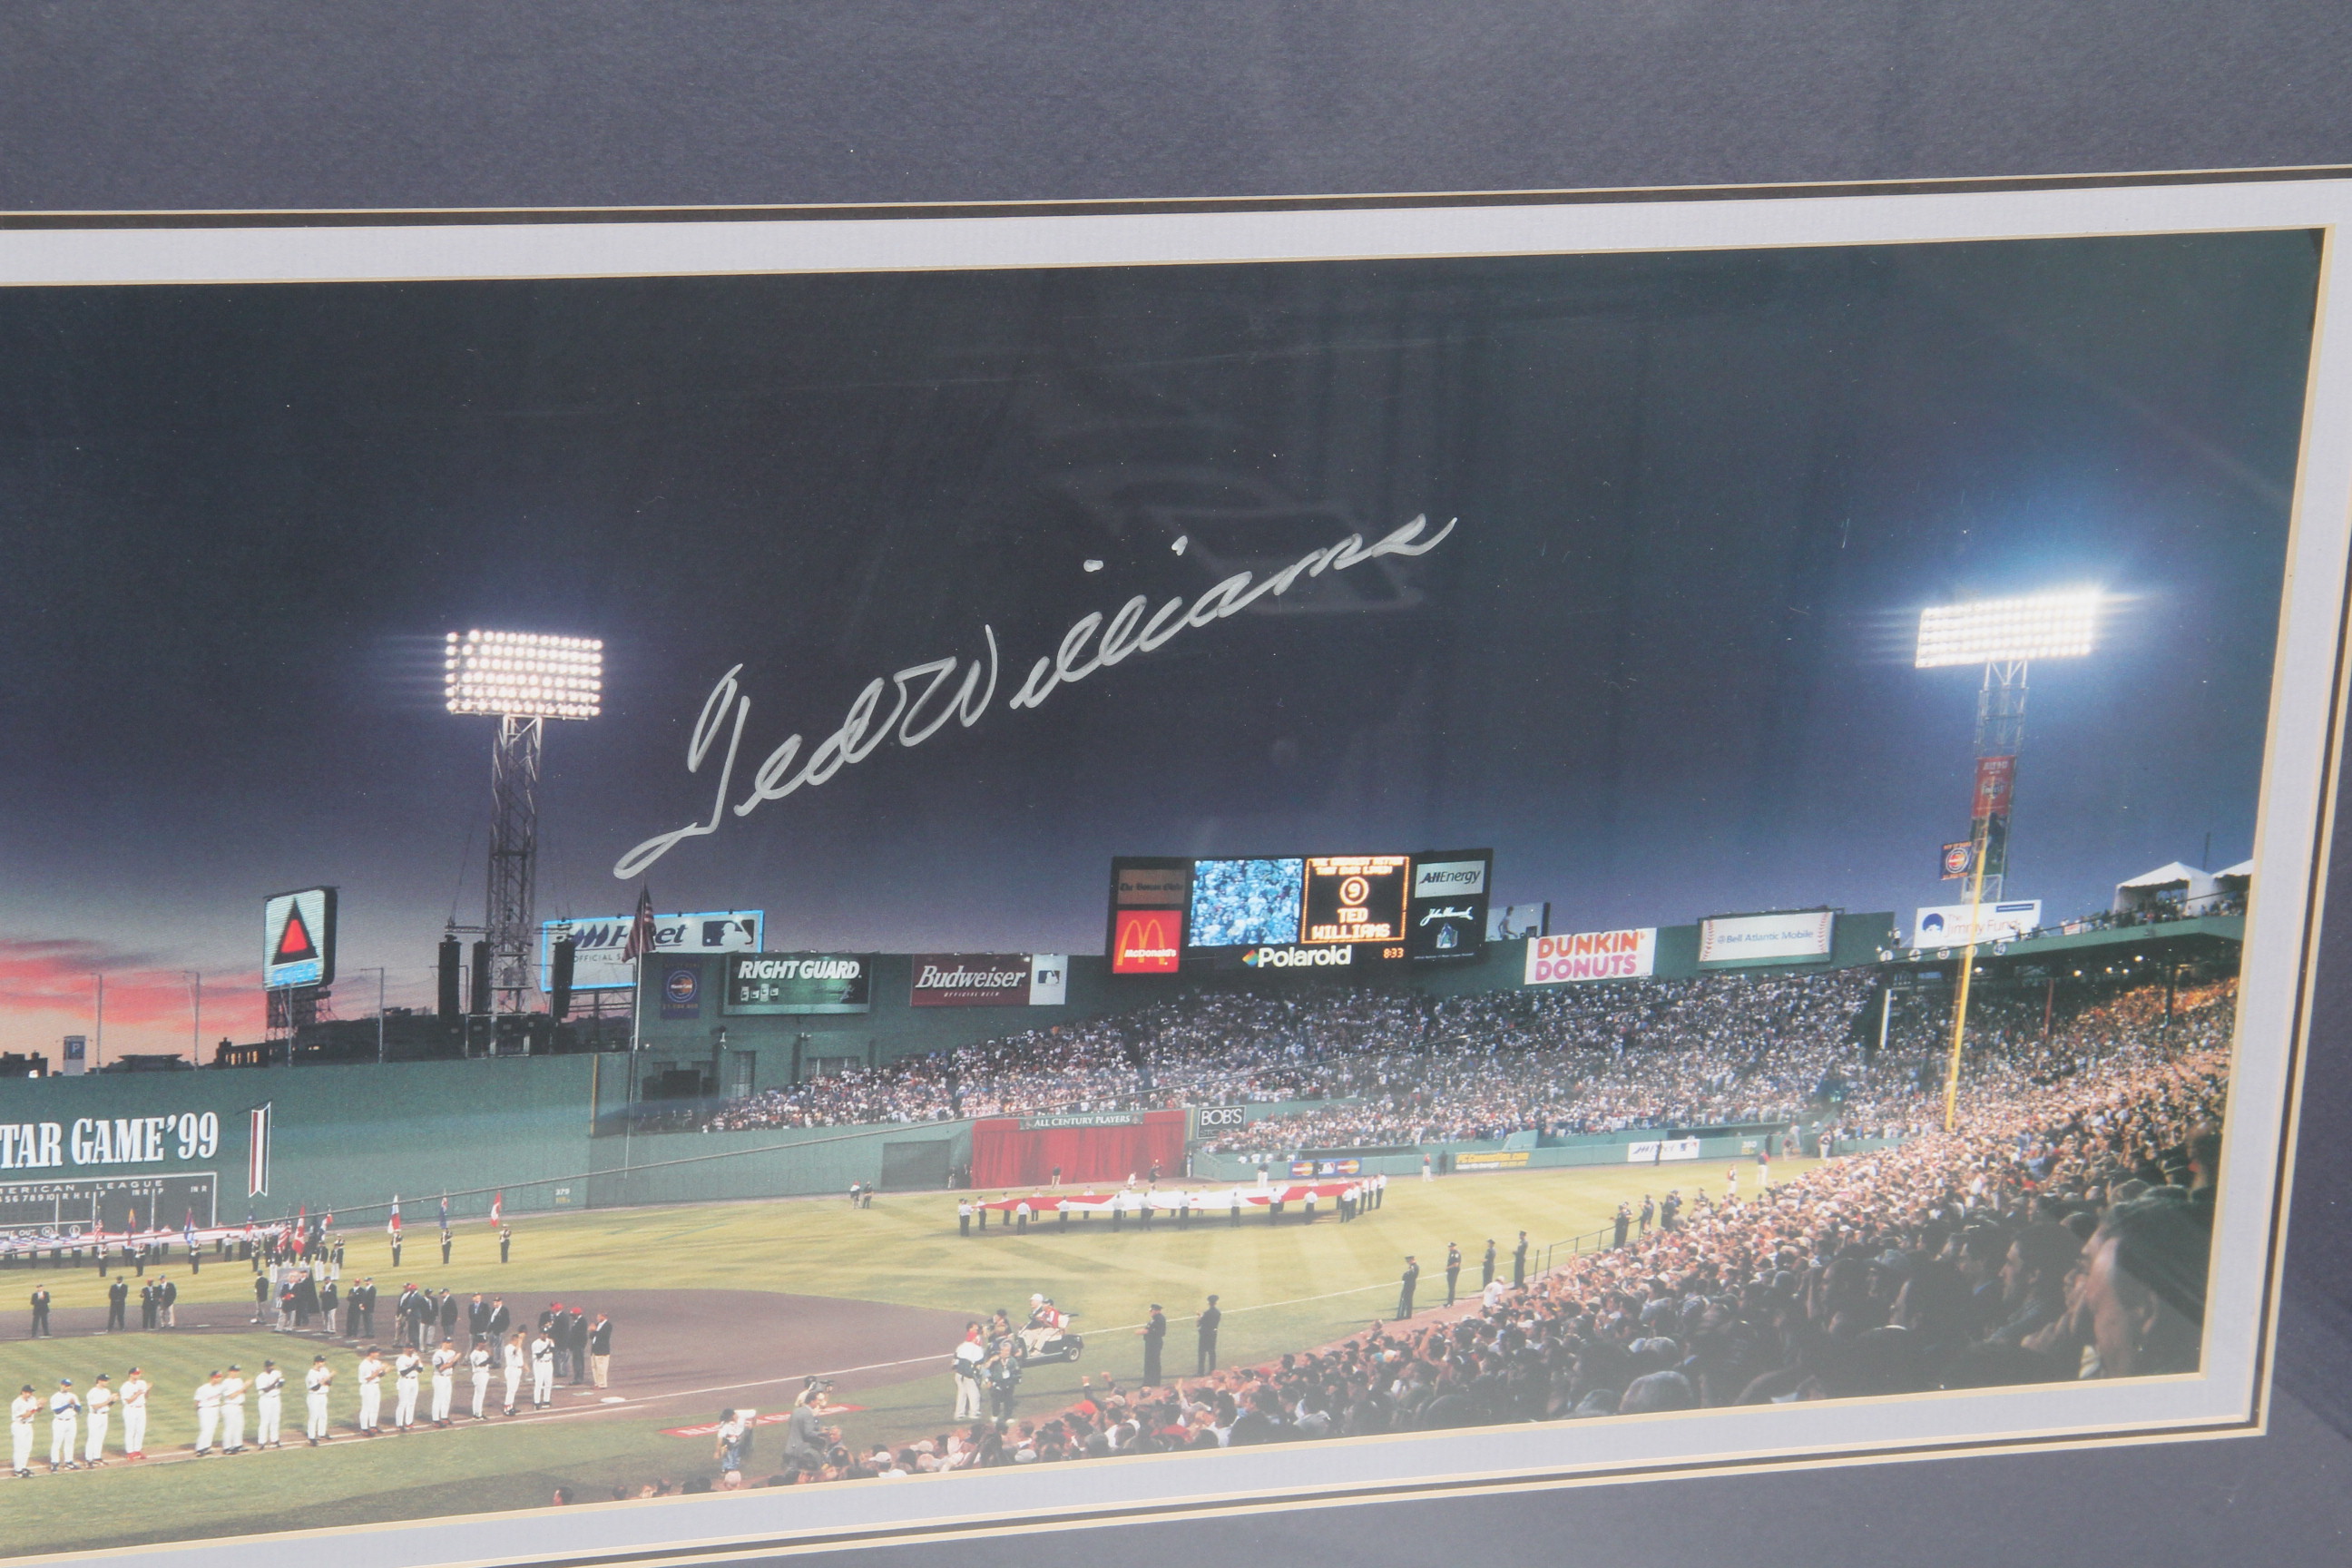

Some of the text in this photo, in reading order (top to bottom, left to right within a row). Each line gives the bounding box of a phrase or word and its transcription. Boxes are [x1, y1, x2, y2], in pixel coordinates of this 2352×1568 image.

[612, 514, 1457, 878] Ted Williams
[1419, 870, 1481, 885] AllEnergy
[1348, 882, 1361, 898] 9
[1337, 907, 1368, 924] TED
[1311, 923, 1391, 940] WILLIAMS
[1726, 930, 1814, 943] Bell Atlantic Mobile
[1258, 945, 1352, 968] Polaroid
[1383, 947, 1404, 958] 8:33
[738, 960, 800, 979] RIGHT
[1535, 954, 1637, 981] DONUTS
[915, 965, 1026, 988] Budweiser
[1034, 1114, 1131, 1127] ALL CENTURY PLAYERS
[1200, 1108, 1243, 1126] BOB'S
[0, 1122, 64, 1169] TAR
[95, 1180, 163, 1191] LEAGUE
